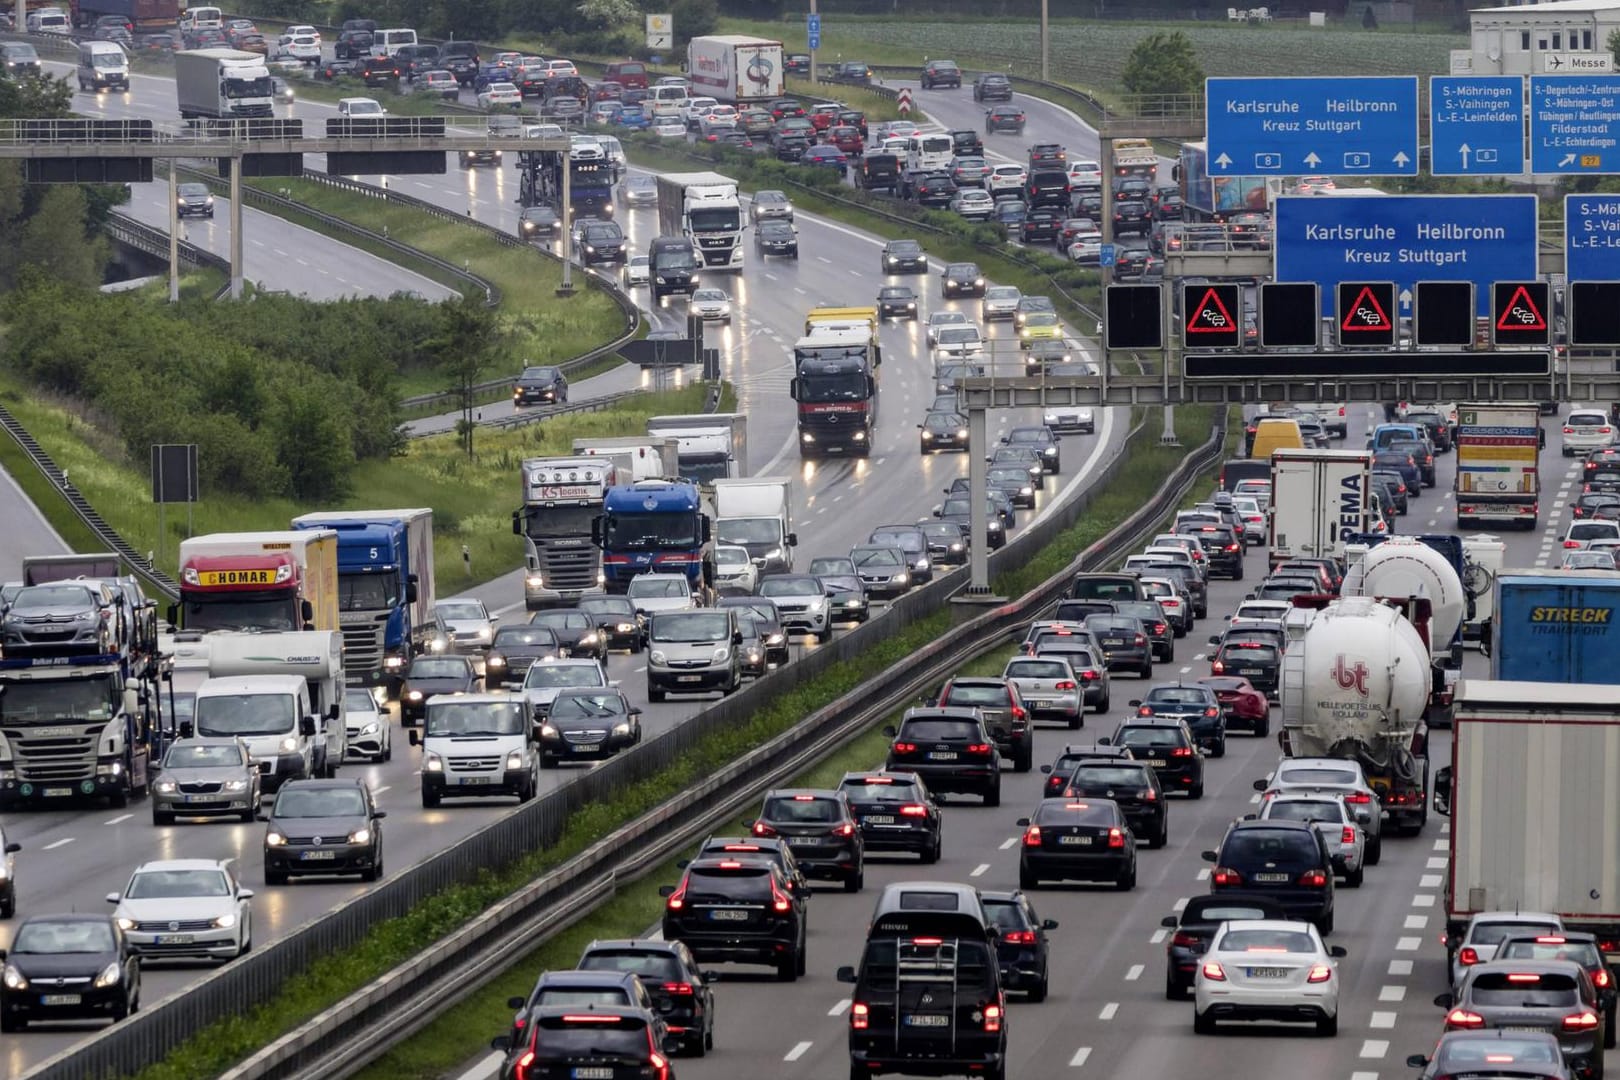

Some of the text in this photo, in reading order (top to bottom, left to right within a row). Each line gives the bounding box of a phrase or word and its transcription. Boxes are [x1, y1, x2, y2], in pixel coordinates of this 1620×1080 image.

[1572, 58, 1606, 68] Messe
[1442, 86, 1512, 98] S.-Möhringen
[1227, 99, 1397, 113] Karlsruhe Heilbronn
[1445, 99, 1510, 111] S.-Vaihingen
[1545, 97, 1614, 110] S.-Möhringen-Ost
[1438, 112, 1518, 123] L.-E.-Leinfelden
[1263, 119, 1361, 133] Kreuz Stuttgart
[1551, 123, 1608, 134] Filderstadt
[1543, 136, 1616, 149] L.-E.-Echterdingen
[1265, 156, 1272, 166] 8
[1353, 155, 1360, 165] 8
[1585, 157, 1596, 165] 27
[1306, 223, 1505, 241] Karlsruhe Heilbronn
[1345, 248, 1467, 266] Kreuz Stuttgart
[1465, 412, 1473, 424] d
[542, 486, 558, 498] KS
[1340, 474, 1361, 542] PEMA
[369, 547, 378, 559] 5
[208, 571, 268, 584] CHOMAR
[1531, 607, 1610, 623] STRECK
[1330, 652, 1370, 699] bt
[1317, 701, 1381, 711] HELLEVOETSLUIS
[1332, 710, 1369, 719] HOLLAND
